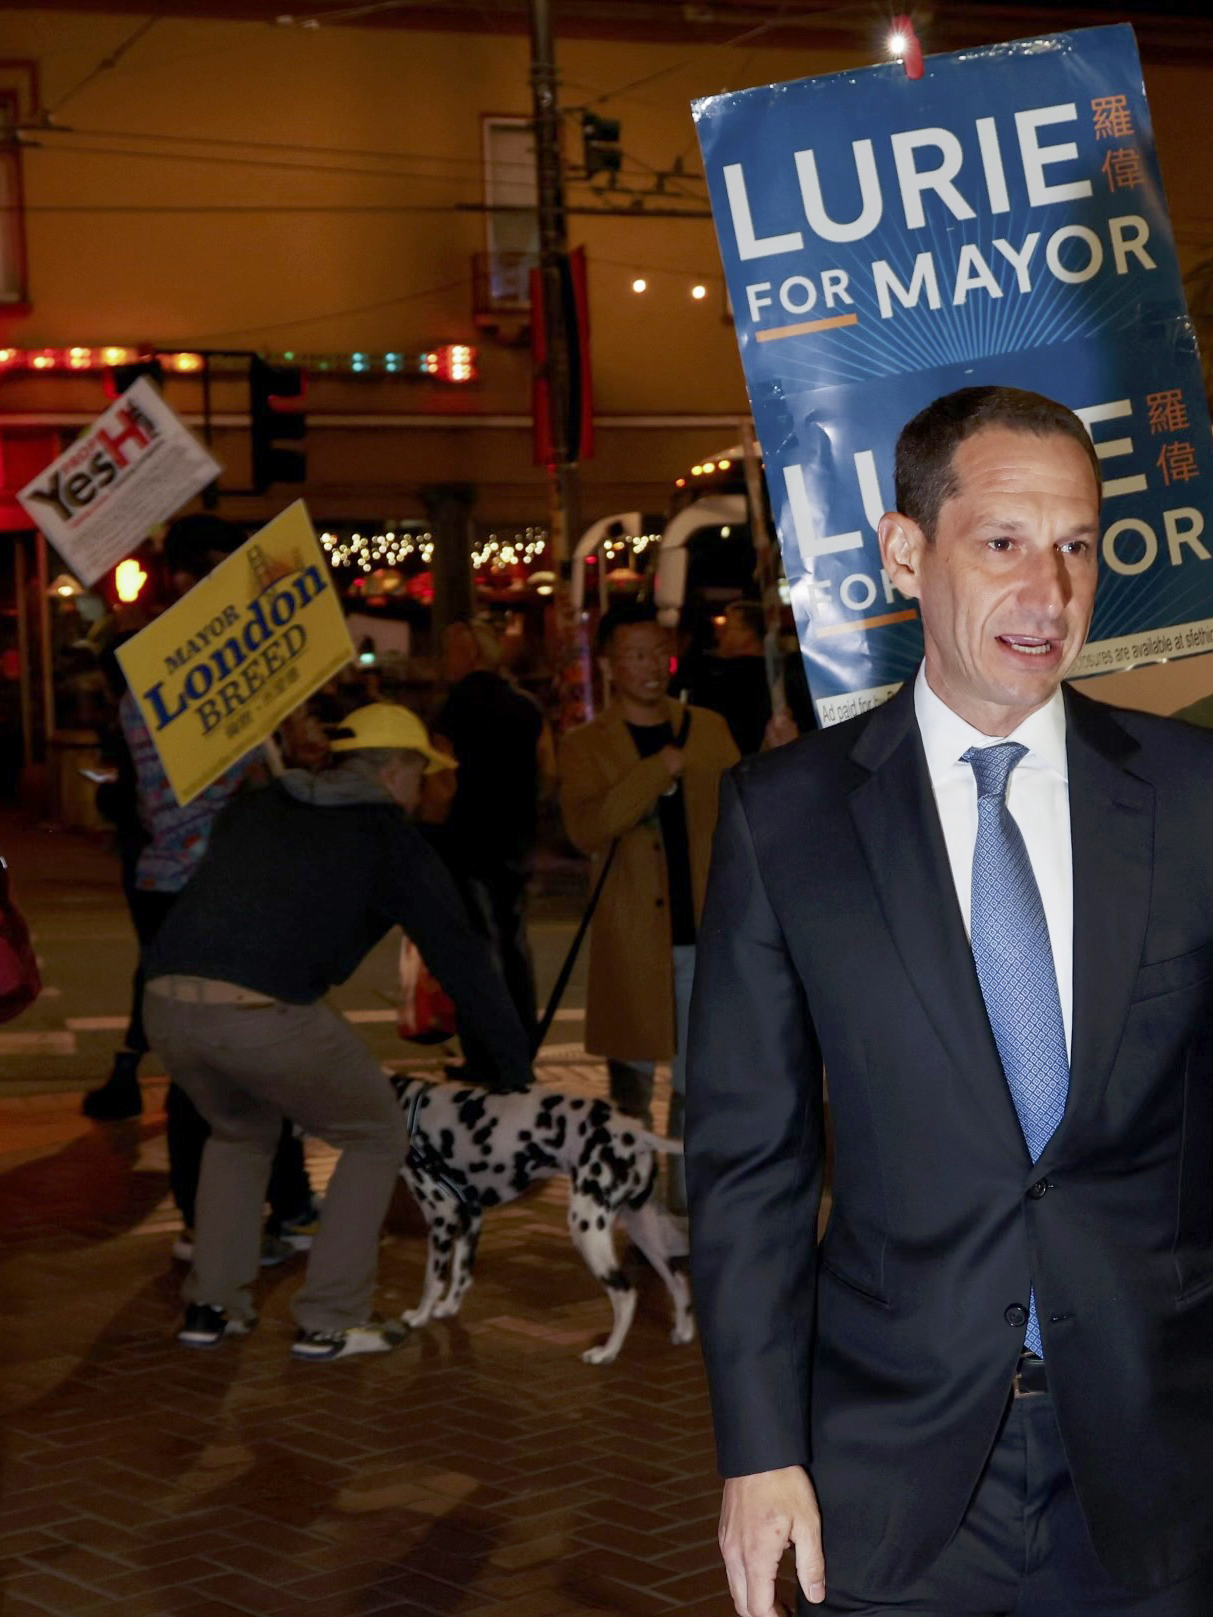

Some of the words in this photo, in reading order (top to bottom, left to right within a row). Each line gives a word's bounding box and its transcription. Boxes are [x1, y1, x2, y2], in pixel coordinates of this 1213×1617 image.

[723, 102, 1093, 261] LURIE
[1091, 94, 1143, 193] 羅偉
[745, 268, 855, 322] FOR
[871, 214, 1157, 319] MAYOR
[29, 450, 118, 523] Yes
[1146, 388, 1200, 487] 羅偉
[142, 564, 328, 733] London
[163, 604, 241, 675] MAYOR
[195, 623, 308, 737] BREED
[1115, 647, 1131, 662] are
[1131, 639, 1173, 660] available
[1174, 635, 1184, 650] at
[822, 703, 836, 722] Ad
[837, 698, 858, 722] paid
